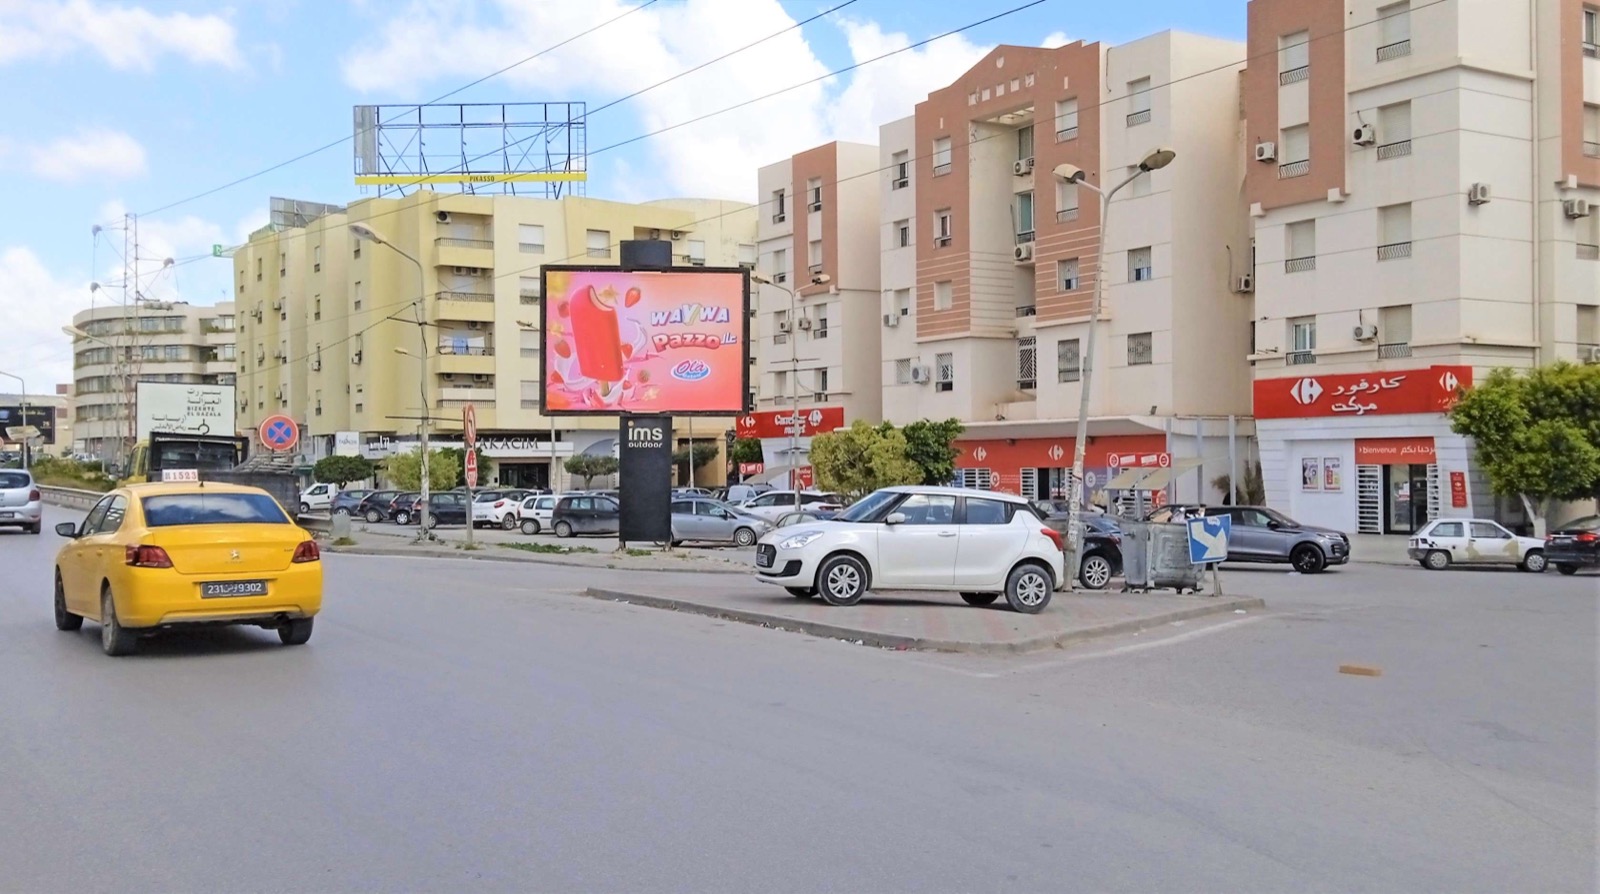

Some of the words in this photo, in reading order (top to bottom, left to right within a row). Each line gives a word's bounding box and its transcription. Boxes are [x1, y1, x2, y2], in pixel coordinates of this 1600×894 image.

[651, 303, 730, 326] WAYWA
[652, 333, 720, 352] Pazzo
[1331, 375, 1406, 396] كارفور
[1331, 395, 1378, 415] مركت
[628, 420, 663, 441] ims
[628, 441, 663, 449] outdoor
[1363, 446, 1397, 454] bienvenue
[208, 584, 223, 594] 231
[238, 582, 262, 592] 9302
